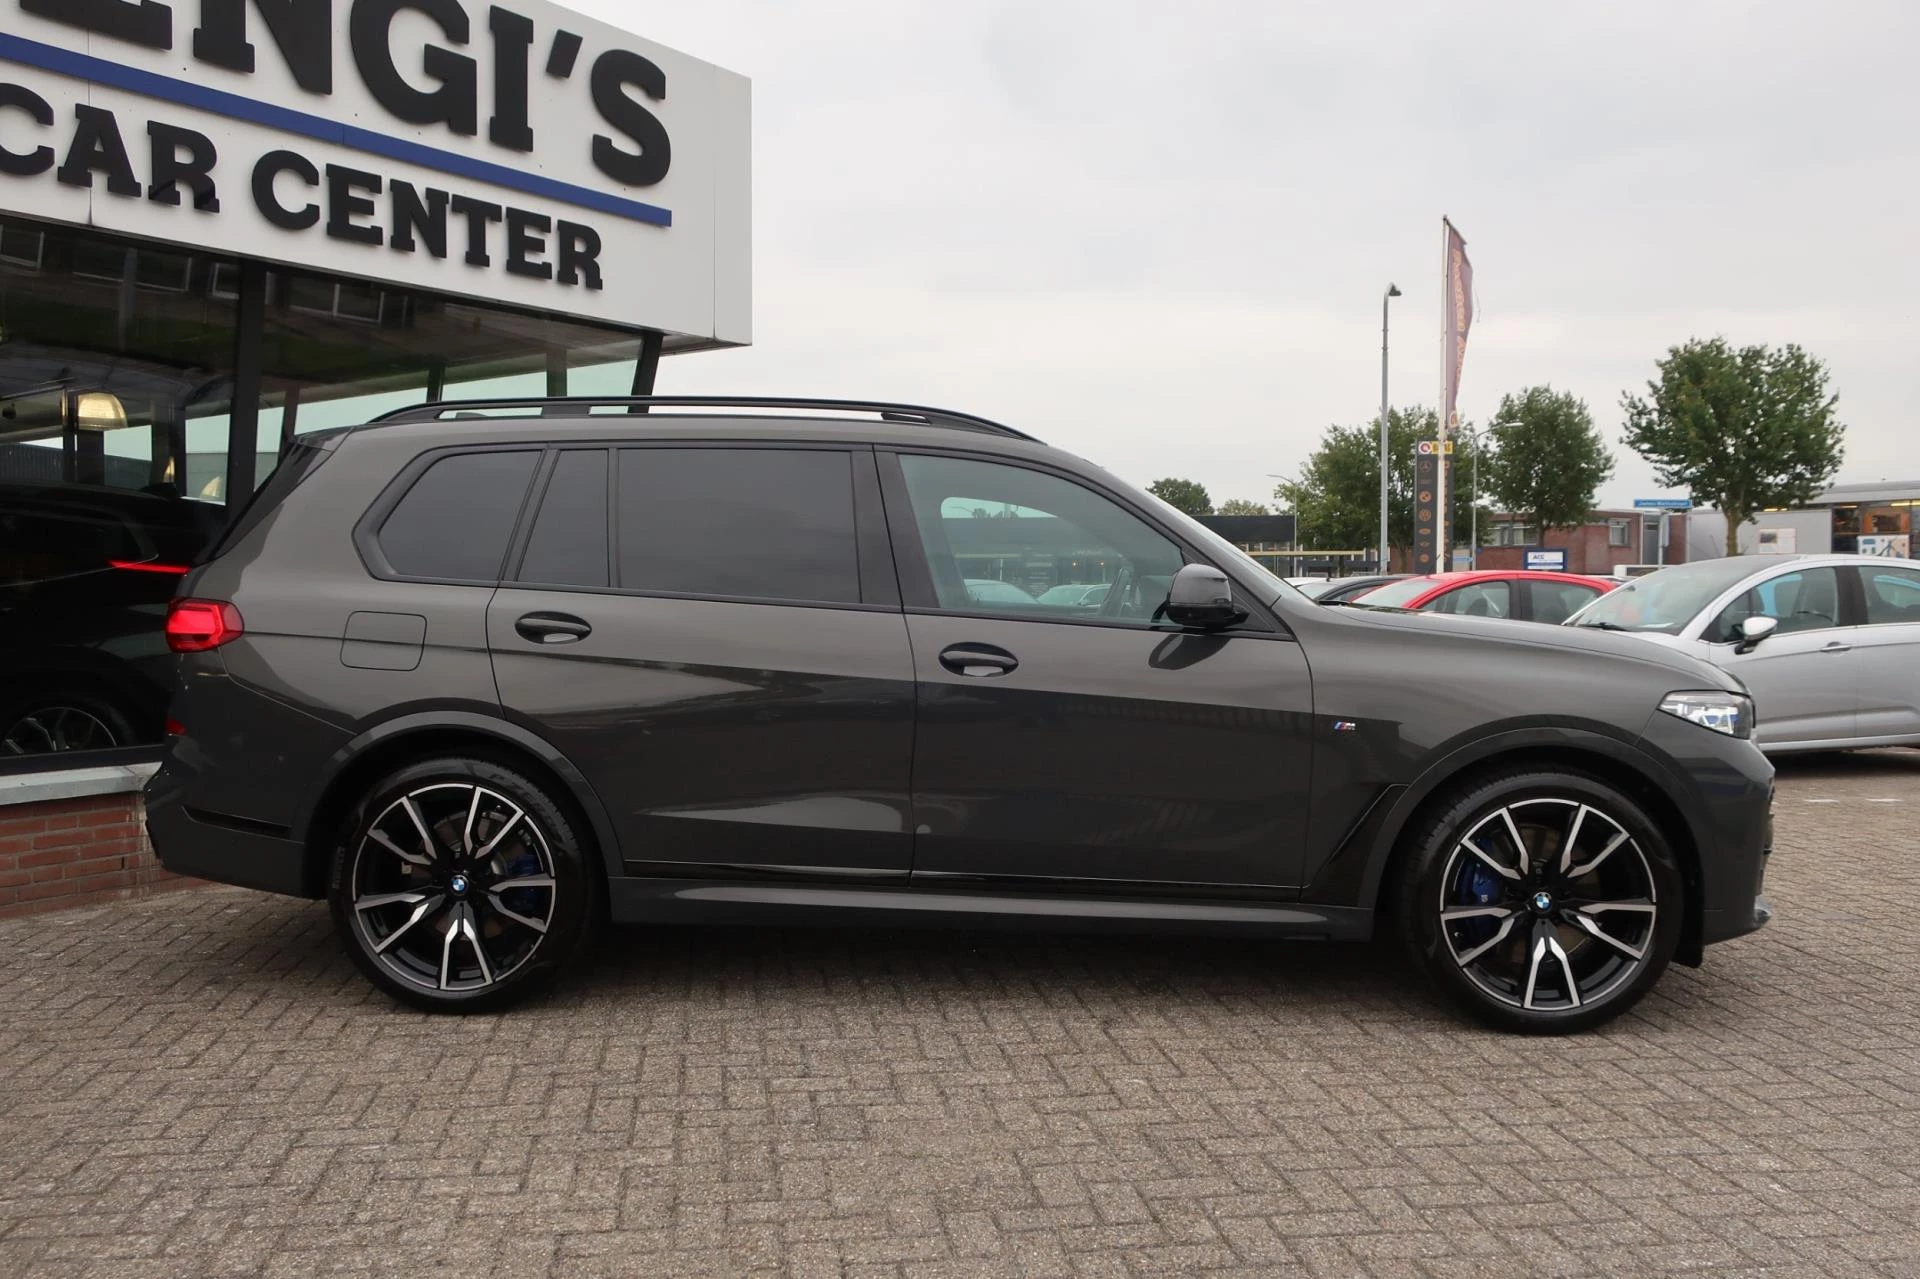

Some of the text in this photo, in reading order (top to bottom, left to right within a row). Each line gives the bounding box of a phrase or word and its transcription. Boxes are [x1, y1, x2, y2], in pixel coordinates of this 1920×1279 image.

[0, 83, 603, 291] CAR CENTER
[19, 0, 671, 188] NGI'S
